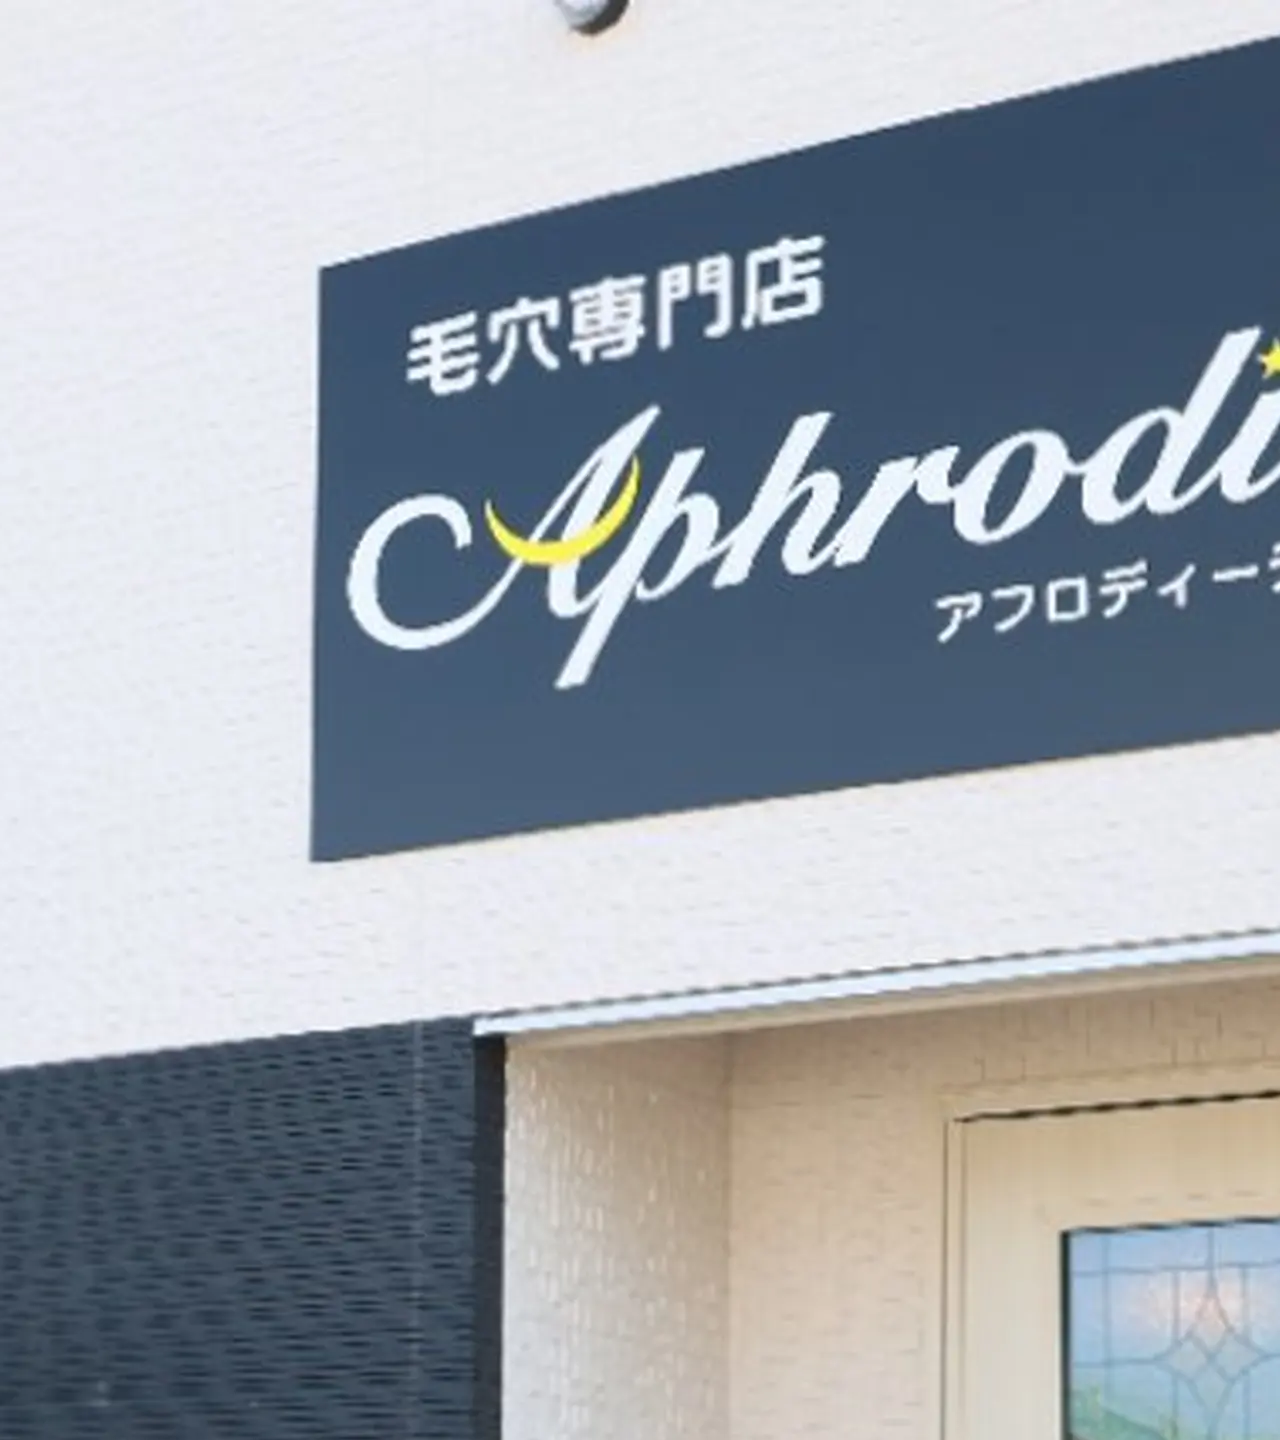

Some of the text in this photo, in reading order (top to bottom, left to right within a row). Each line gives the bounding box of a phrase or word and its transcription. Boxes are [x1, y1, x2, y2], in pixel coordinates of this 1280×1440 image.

[406, 234, 825, 396] 毛穴専門店
